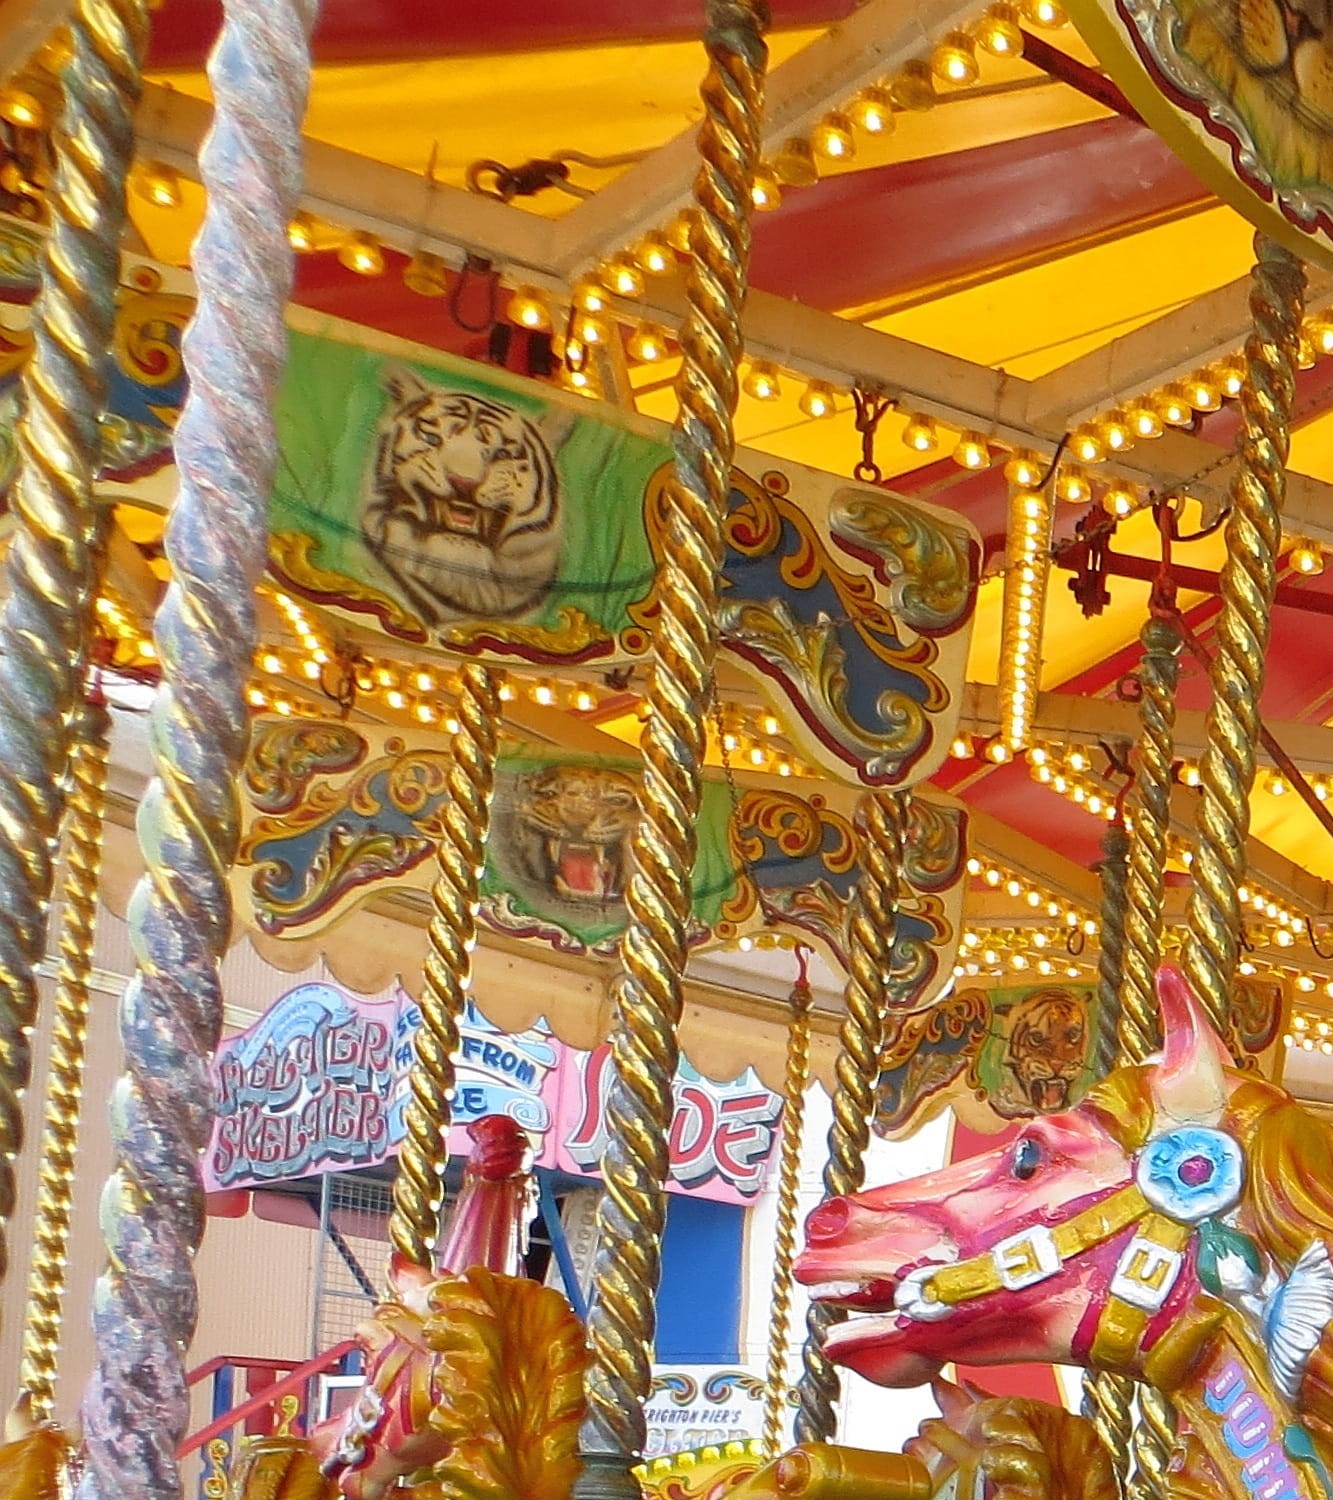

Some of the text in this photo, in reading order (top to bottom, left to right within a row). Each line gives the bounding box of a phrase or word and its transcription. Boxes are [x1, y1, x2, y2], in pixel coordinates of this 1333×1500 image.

[217, 1020, 394, 1106] HELTER
[461, 1036, 537, 1084] FROM
[212, 1076, 388, 1175] SKELTER
[643, 1408, 742, 1424] RIGHTON PIER'S
